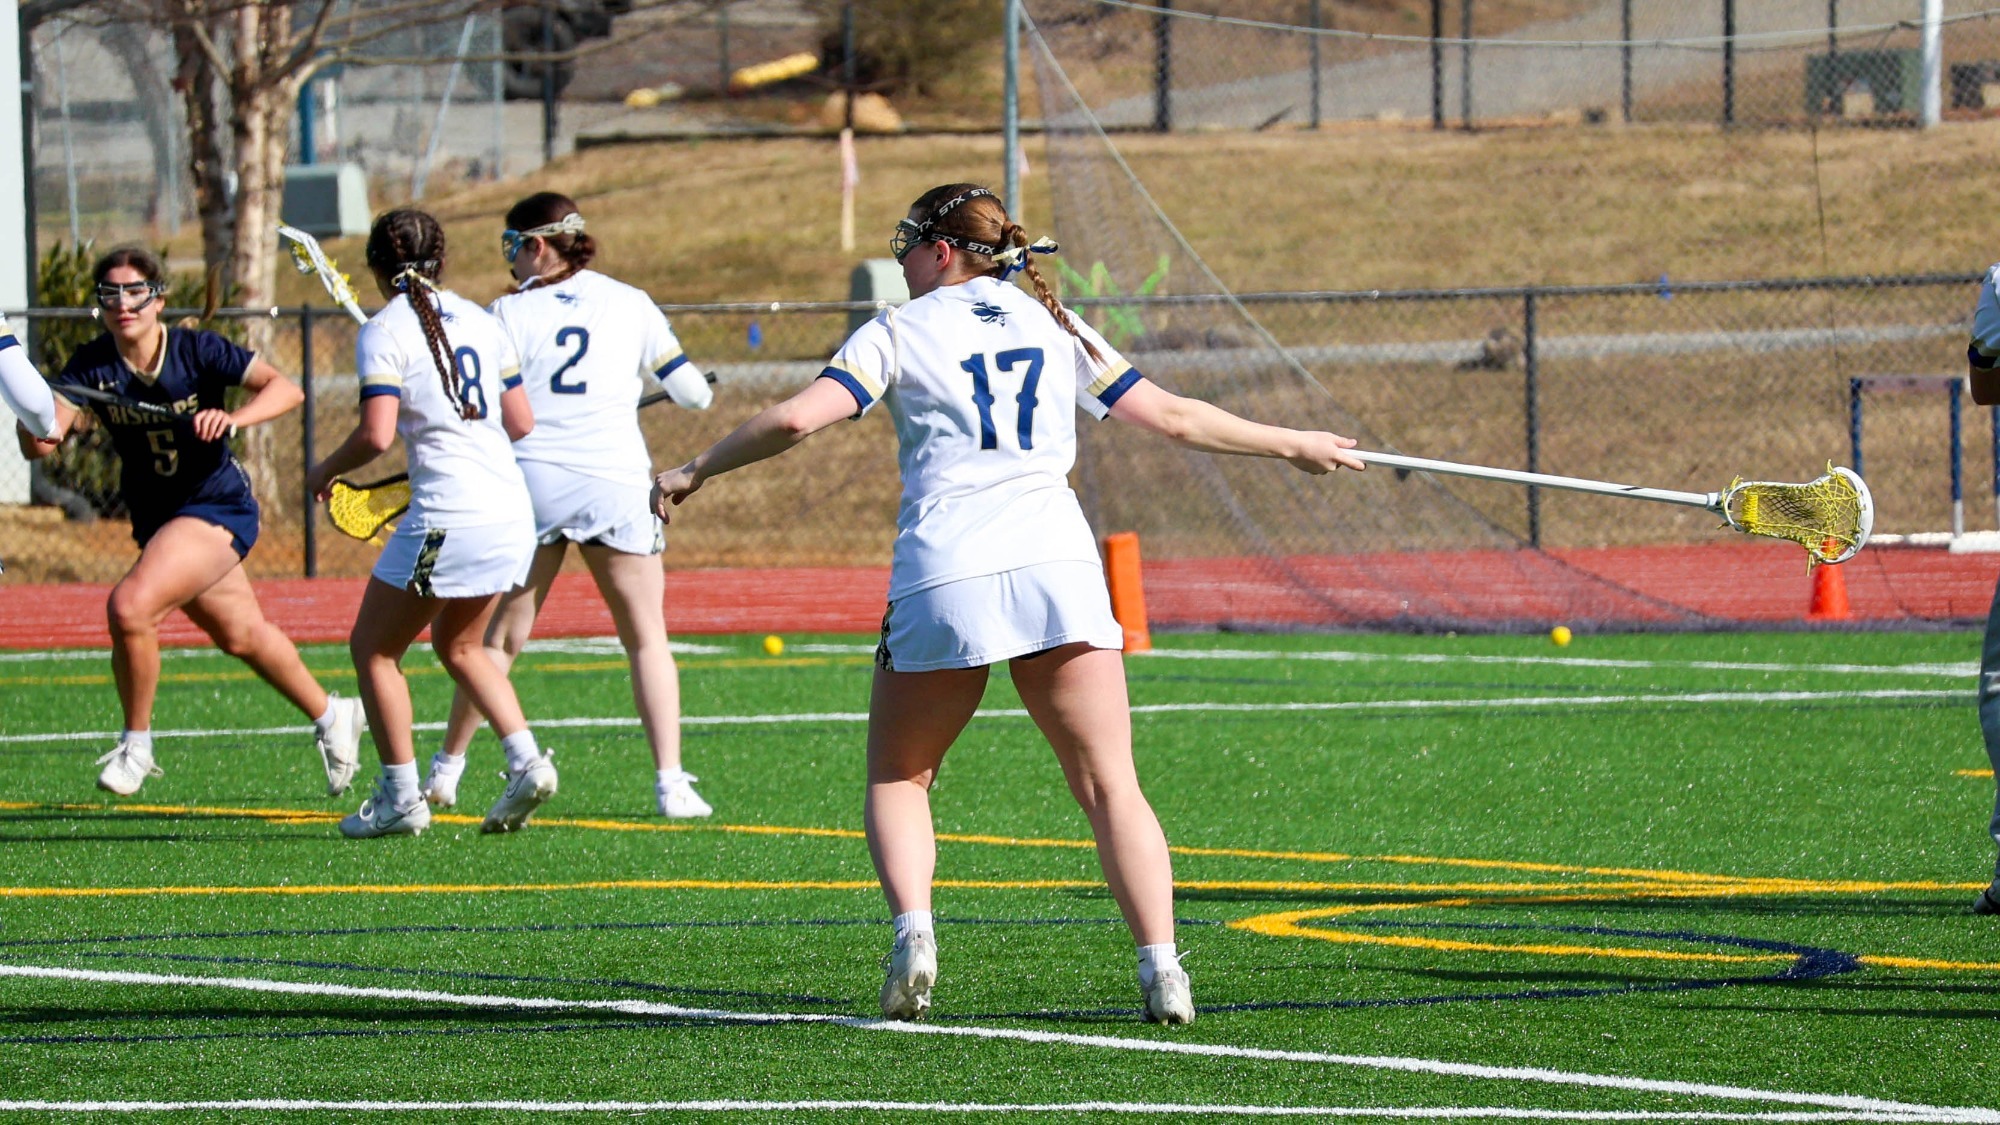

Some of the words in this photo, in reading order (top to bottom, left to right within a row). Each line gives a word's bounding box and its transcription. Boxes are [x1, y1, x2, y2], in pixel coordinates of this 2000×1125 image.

[916, 217, 934, 233] TX
[939, 195, 966, 217] STX
[930, 233, 959, 247] STX
[967, 241, 995, 255] STX
[454, 345, 487, 419] 8
[551, 326, 589, 394] 2
[960, 347, 1045, 452] 17
[146, 429, 179, 476] 5
